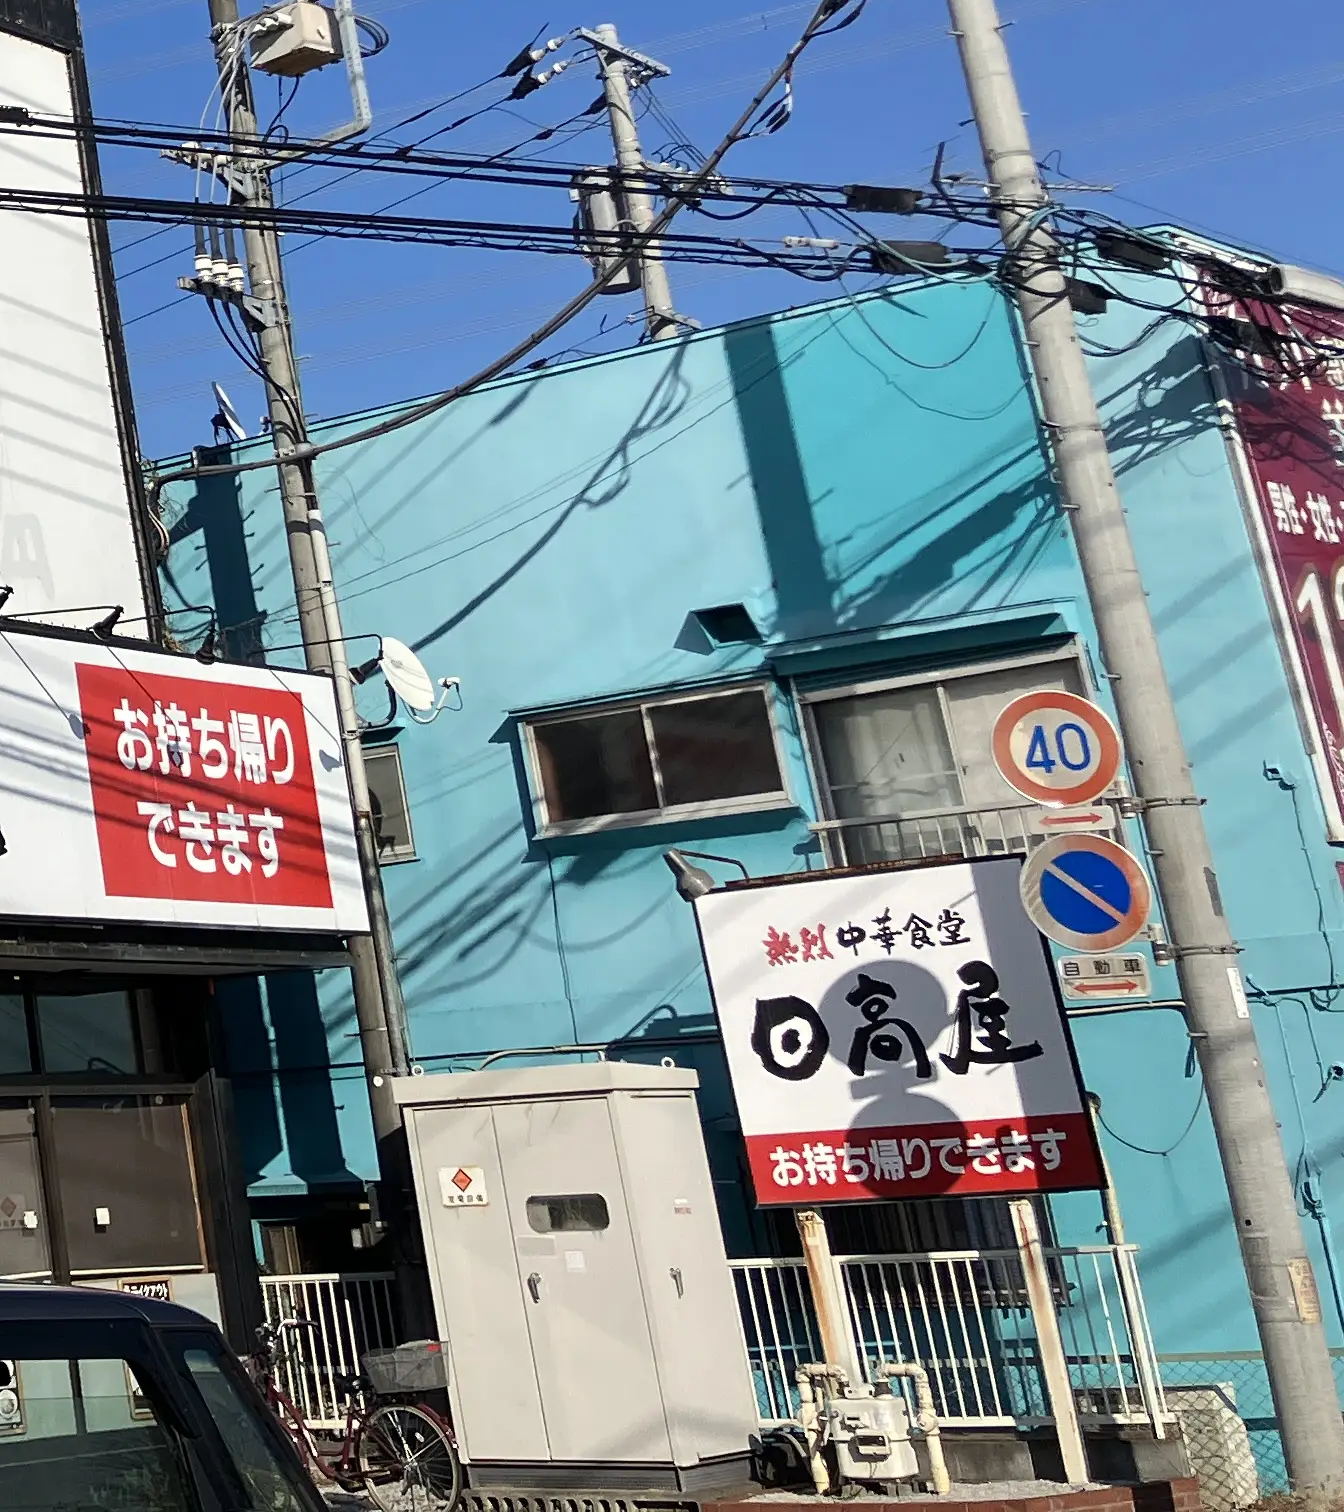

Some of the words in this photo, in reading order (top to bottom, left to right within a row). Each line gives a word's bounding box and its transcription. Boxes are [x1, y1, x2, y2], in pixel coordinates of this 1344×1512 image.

[113, 697, 296, 787] お持ち帰り
[1024, 722, 1092, 775] 40
[137, 800, 285, 880] できます
[762, 923, 835, 967] 熱烈
[837, 907, 971, 955] 中華食堂
[1064, 959, 1141, 976] 自動車
[751, 960, 1042, 1081] 日高屋
[769, 1126, 1068, 1187] お持ち帰りできます
